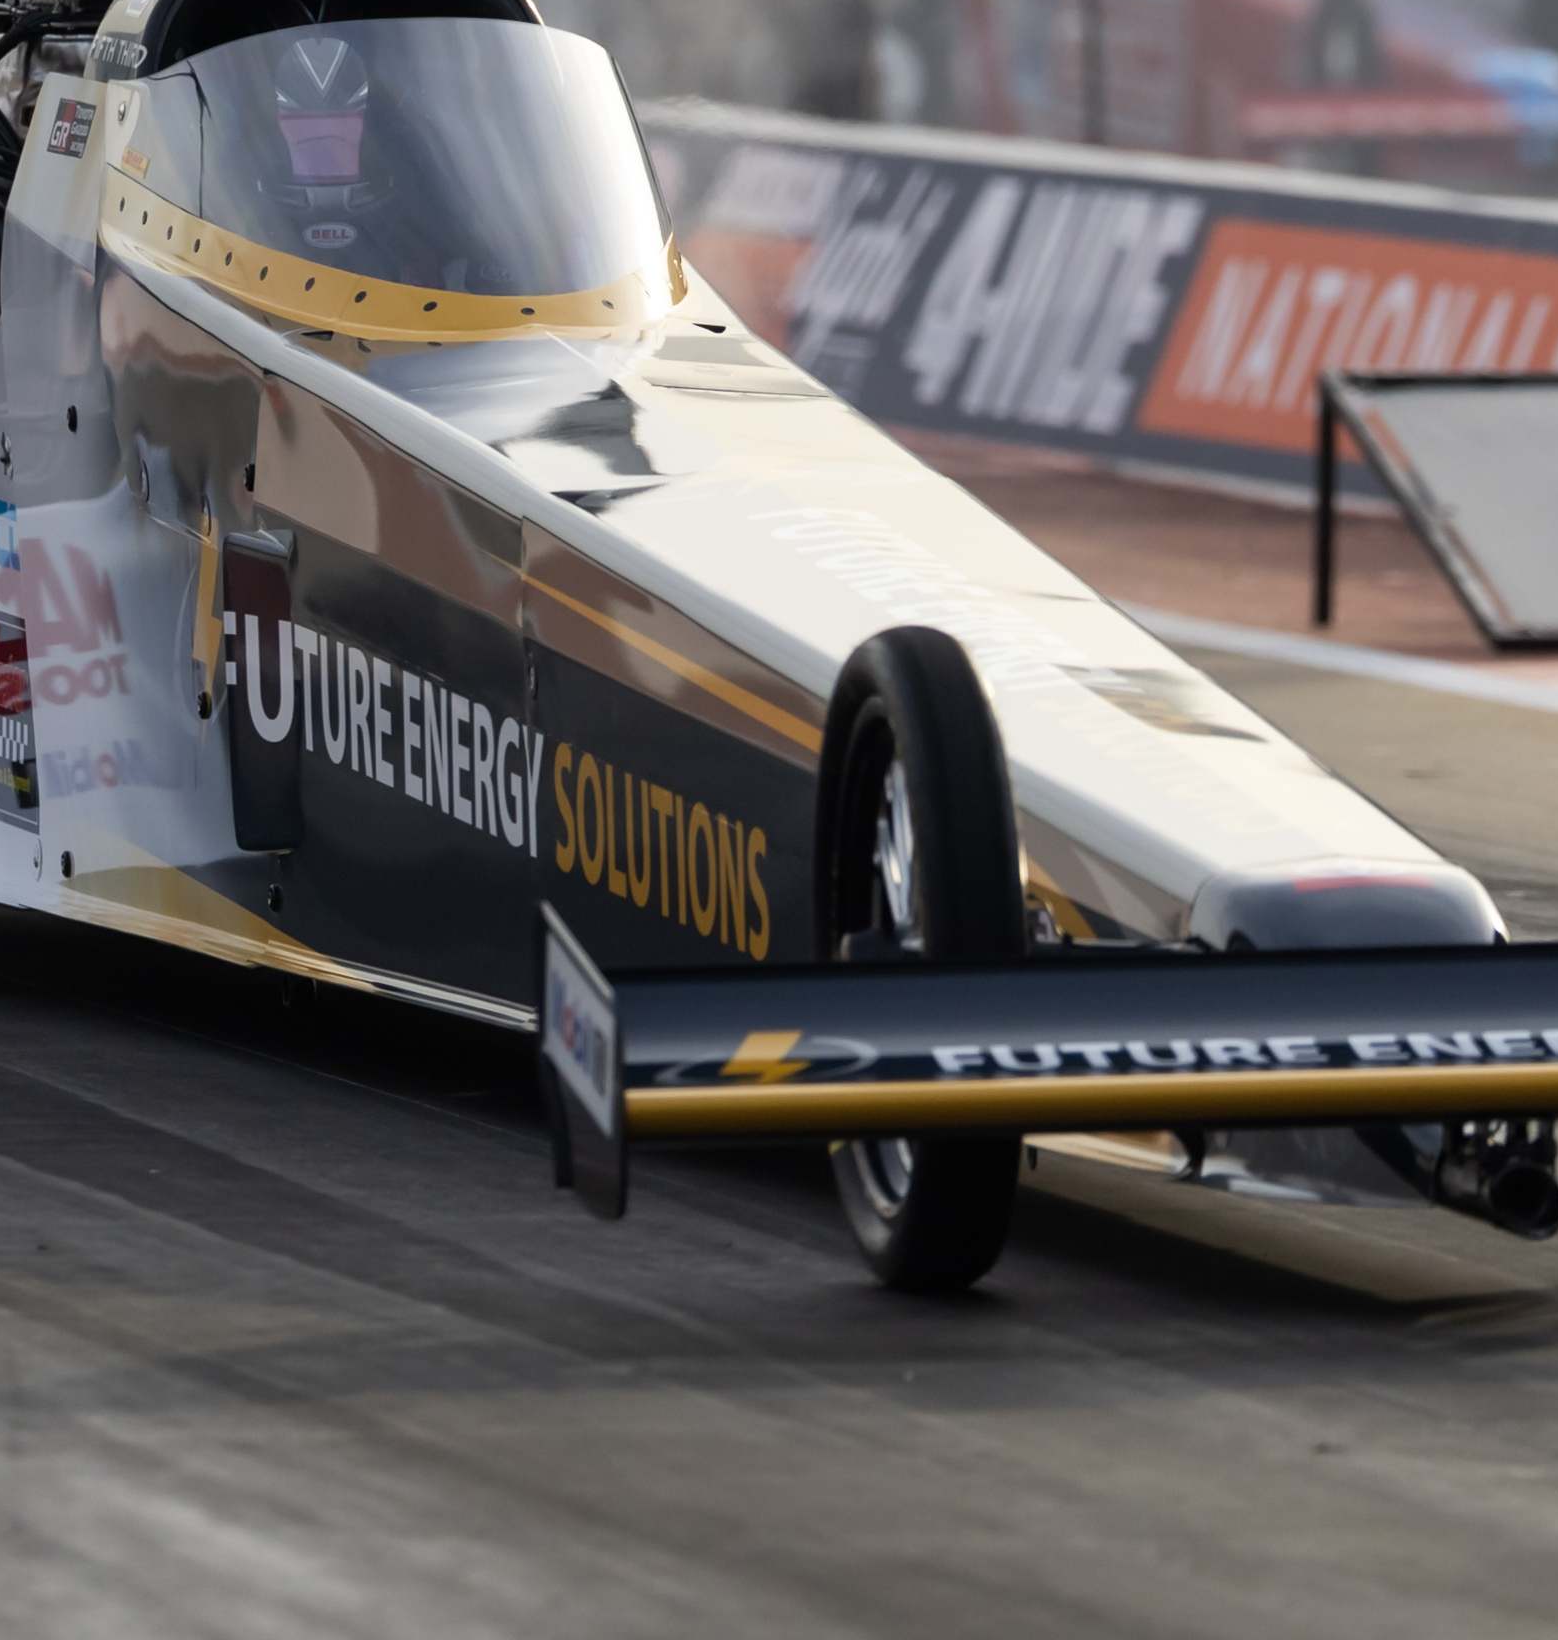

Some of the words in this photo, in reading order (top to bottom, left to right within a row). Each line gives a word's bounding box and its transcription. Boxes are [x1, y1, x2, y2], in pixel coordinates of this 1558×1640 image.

[115, 39, 148, 69] THIRD
[50, 120, 71, 148] GR
[311, 228, 350, 240] BELL
[403, 670, 543, 858] ENERGY
[554, 742, 770, 961] SOLUTIONS
[931, 1035, 1330, 1075] FUTURE
